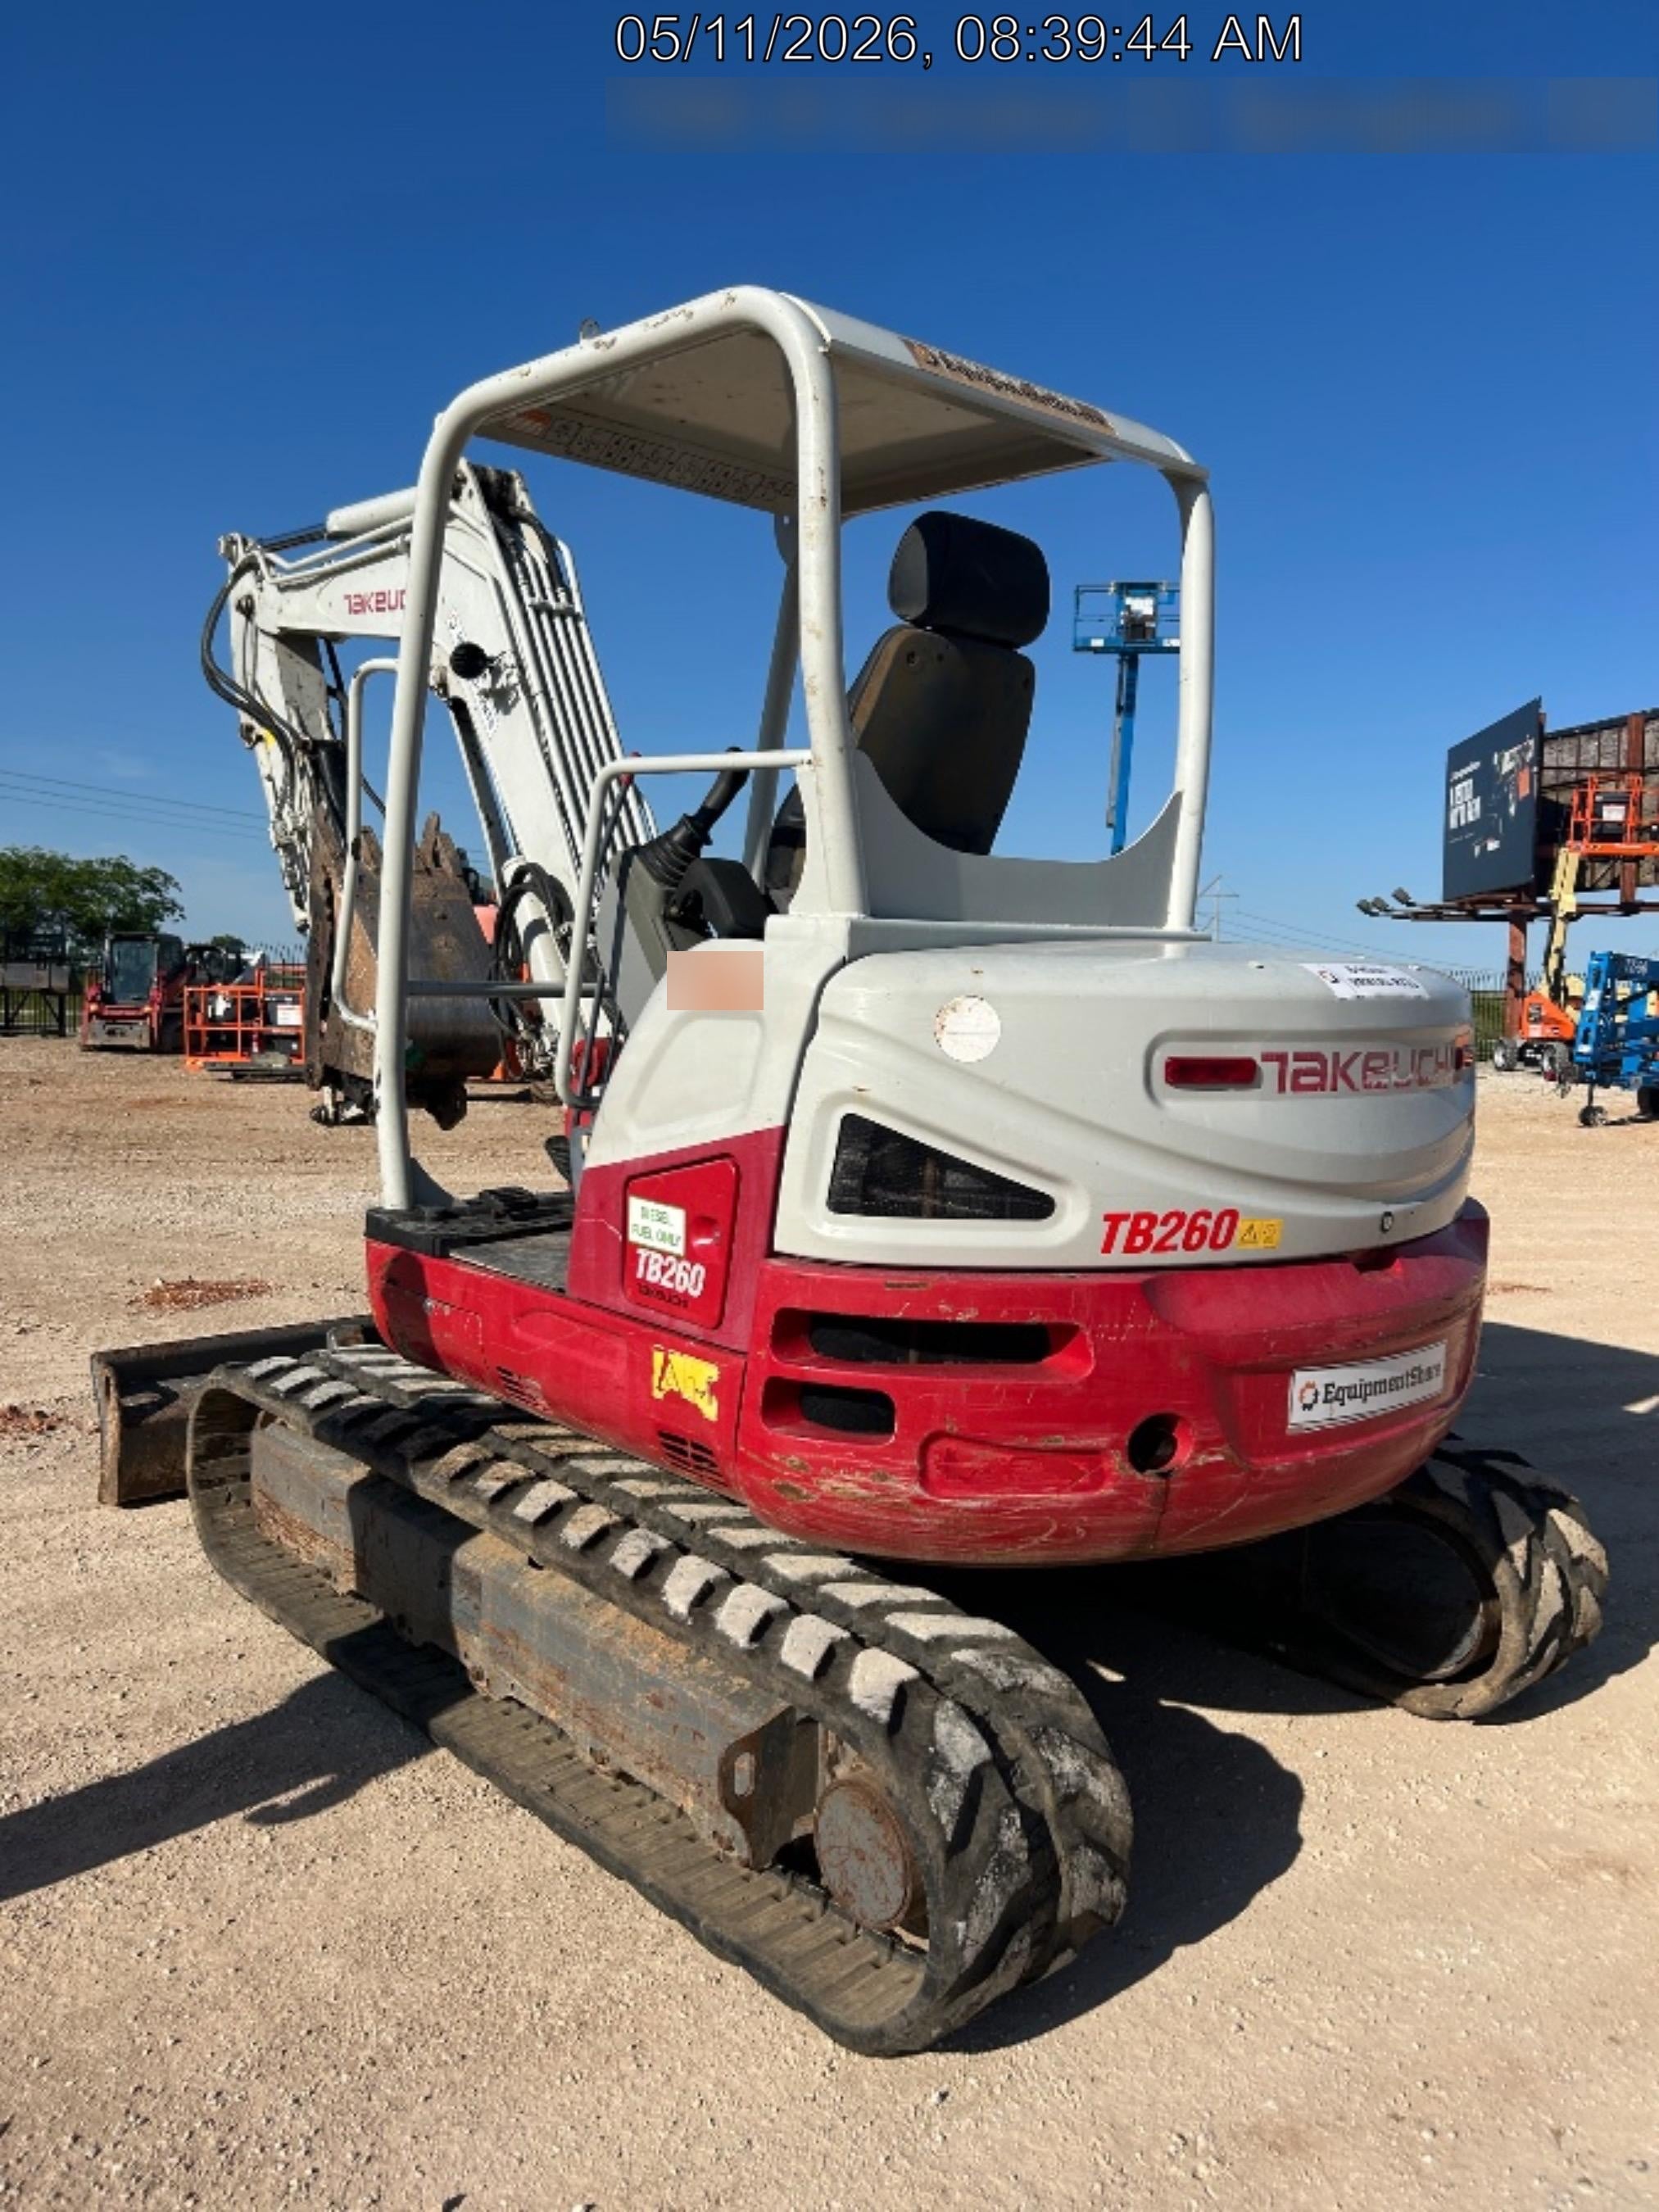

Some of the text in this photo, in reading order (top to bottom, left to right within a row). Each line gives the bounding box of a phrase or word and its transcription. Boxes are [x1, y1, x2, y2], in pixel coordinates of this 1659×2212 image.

[343, 589, 407, 615] TAKEUC
[632, 1223, 682, 1247] FUEL ONLY
[1099, 1208, 1240, 1255] TB260
[636, 1247, 706, 1299] TB260
[1321, 1362, 1442, 1407] EquipmentShare
